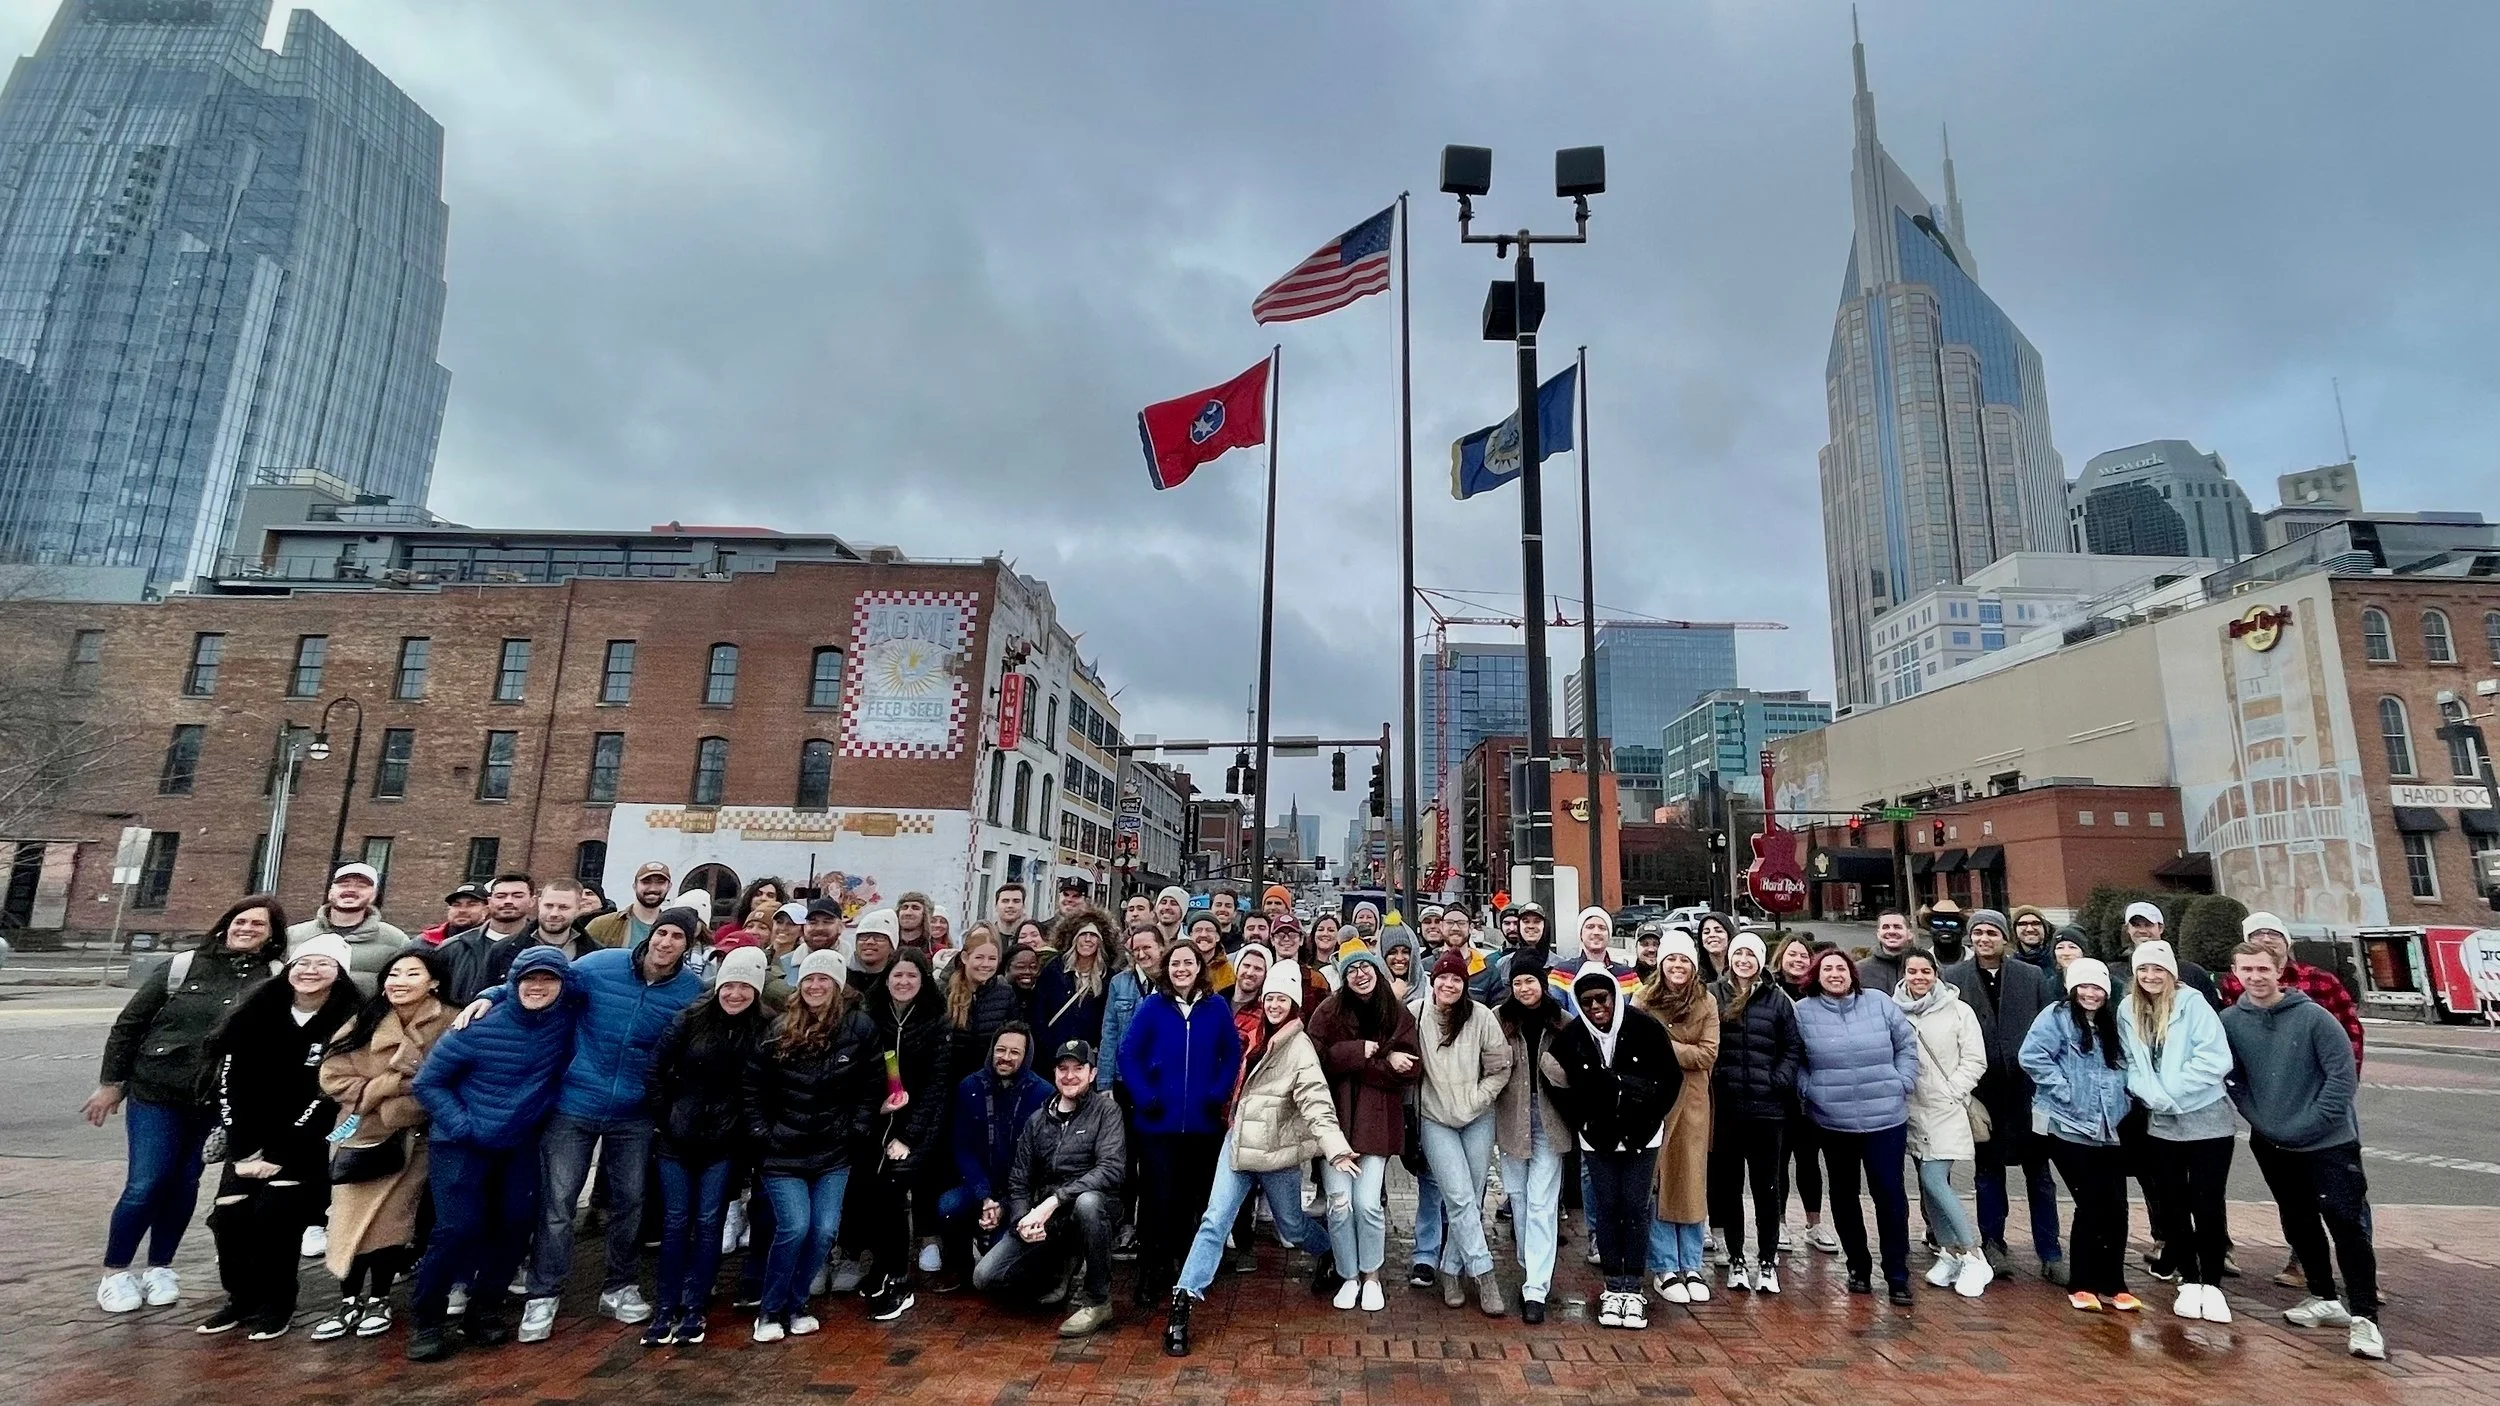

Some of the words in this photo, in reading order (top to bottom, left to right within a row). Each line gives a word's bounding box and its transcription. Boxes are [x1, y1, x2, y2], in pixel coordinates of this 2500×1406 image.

[869, 611, 956, 650] ACME
[867, 702, 901, 717] FEED
[909, 702, 944, 717] SEED
[2402, 787, 2448, 804] HARD
[2453, 788, 2490, 805] ROC
[771, 831, 796, 840] FARM
[1761, 876, 1784, 891] Hard
[1784, 877, 1806, 894] Rock
